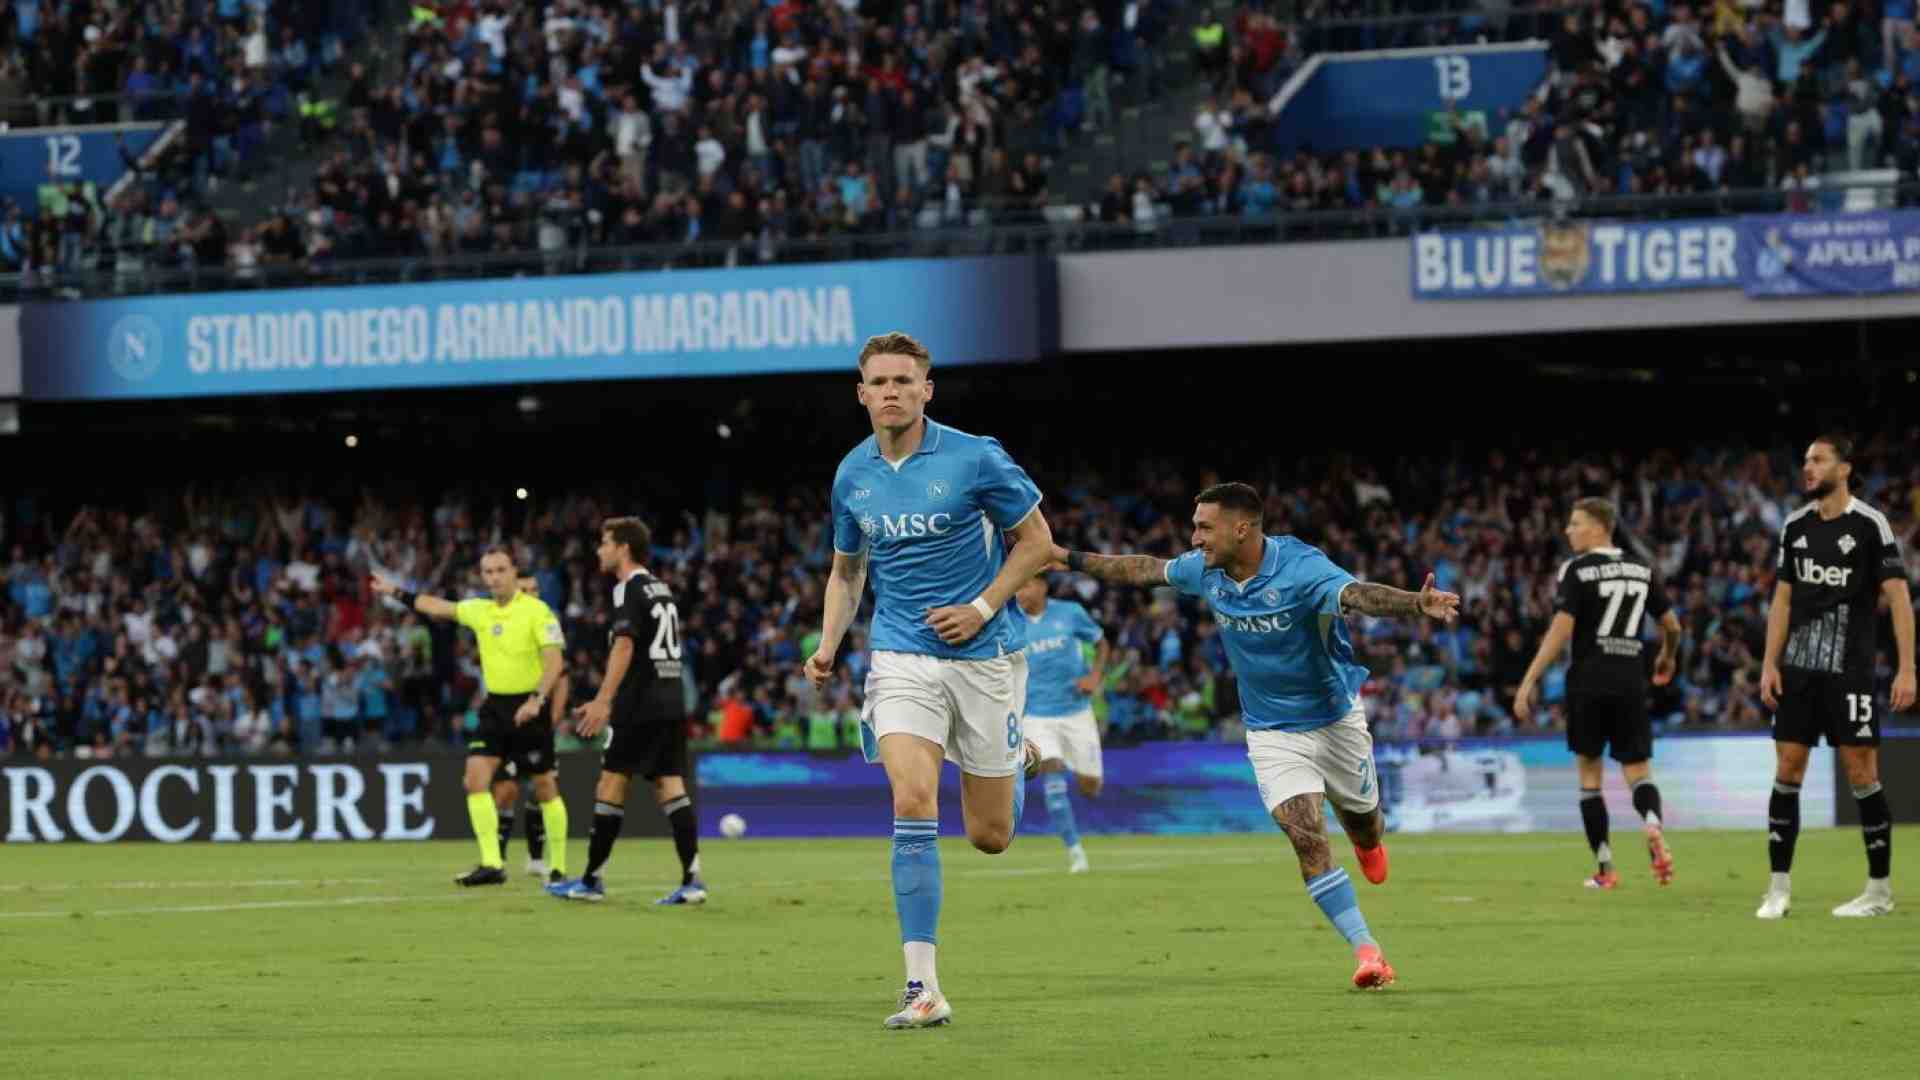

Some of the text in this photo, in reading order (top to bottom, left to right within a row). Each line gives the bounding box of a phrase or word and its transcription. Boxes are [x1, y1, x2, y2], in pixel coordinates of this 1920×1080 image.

[1433, 55, 1471, 99] 13
[46, 134, 82, 175] 12
[1415, 226, 1738, 291] BLUE TIGER
[1807, 239, 1899, 267] APULIA
[186, 283, 855, 374] STADIO DIEGO ARMANDO MARADONA
[881, 512, 952, 537] MSC
[1794, 556, 1853, 587] Uber
[1236, 611, 1293, 633] MSC
[1596, 579, 1649, 638] 77
[648, 601, 682, 660] 20
[1846, 693, 1873, 723] 13
[1007, 711, 1019, 749] 8
[1359, 757, 1376, 796] 2
[3, 763, 435, 842] ROCIERE
